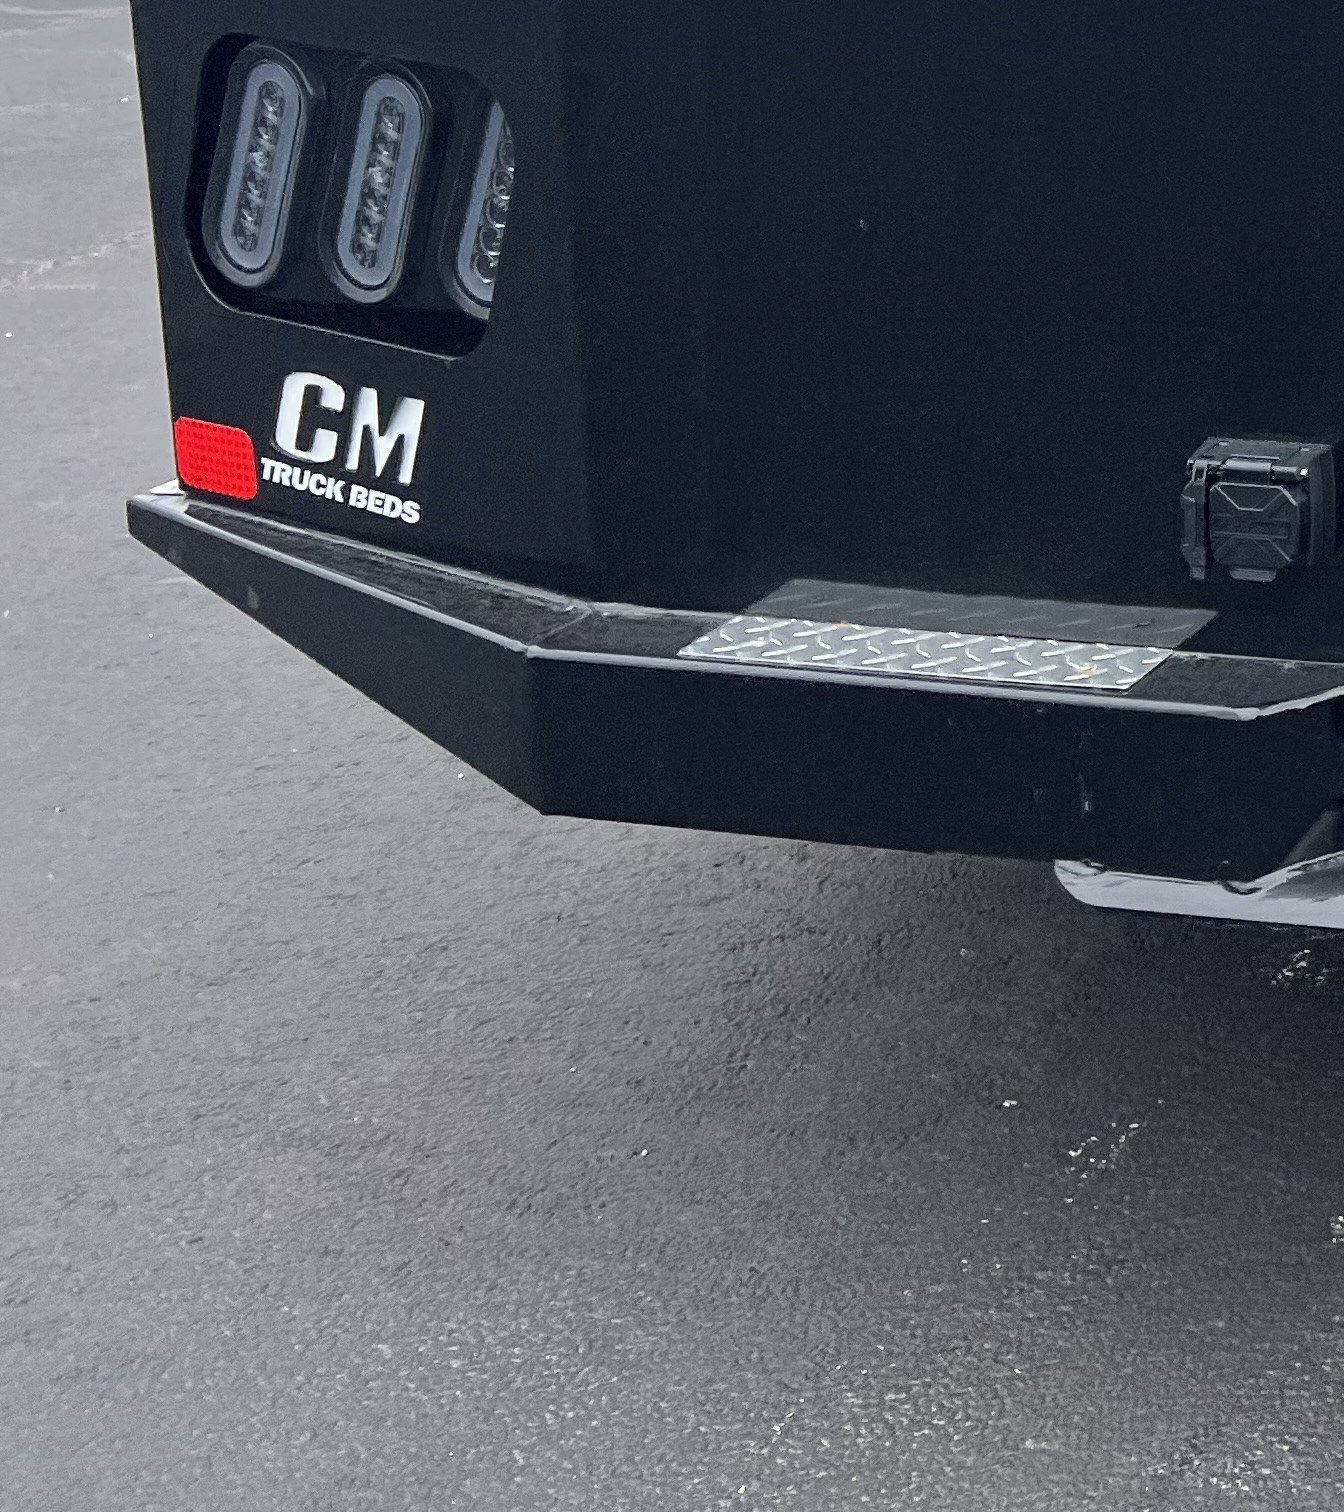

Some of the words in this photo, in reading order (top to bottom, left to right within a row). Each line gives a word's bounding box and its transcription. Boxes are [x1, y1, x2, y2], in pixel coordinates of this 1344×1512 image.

[272, 372, 425, 487] CM
[260, 457, 347, 503] TRUCK
[349, 483, 421, 524] BEDS
